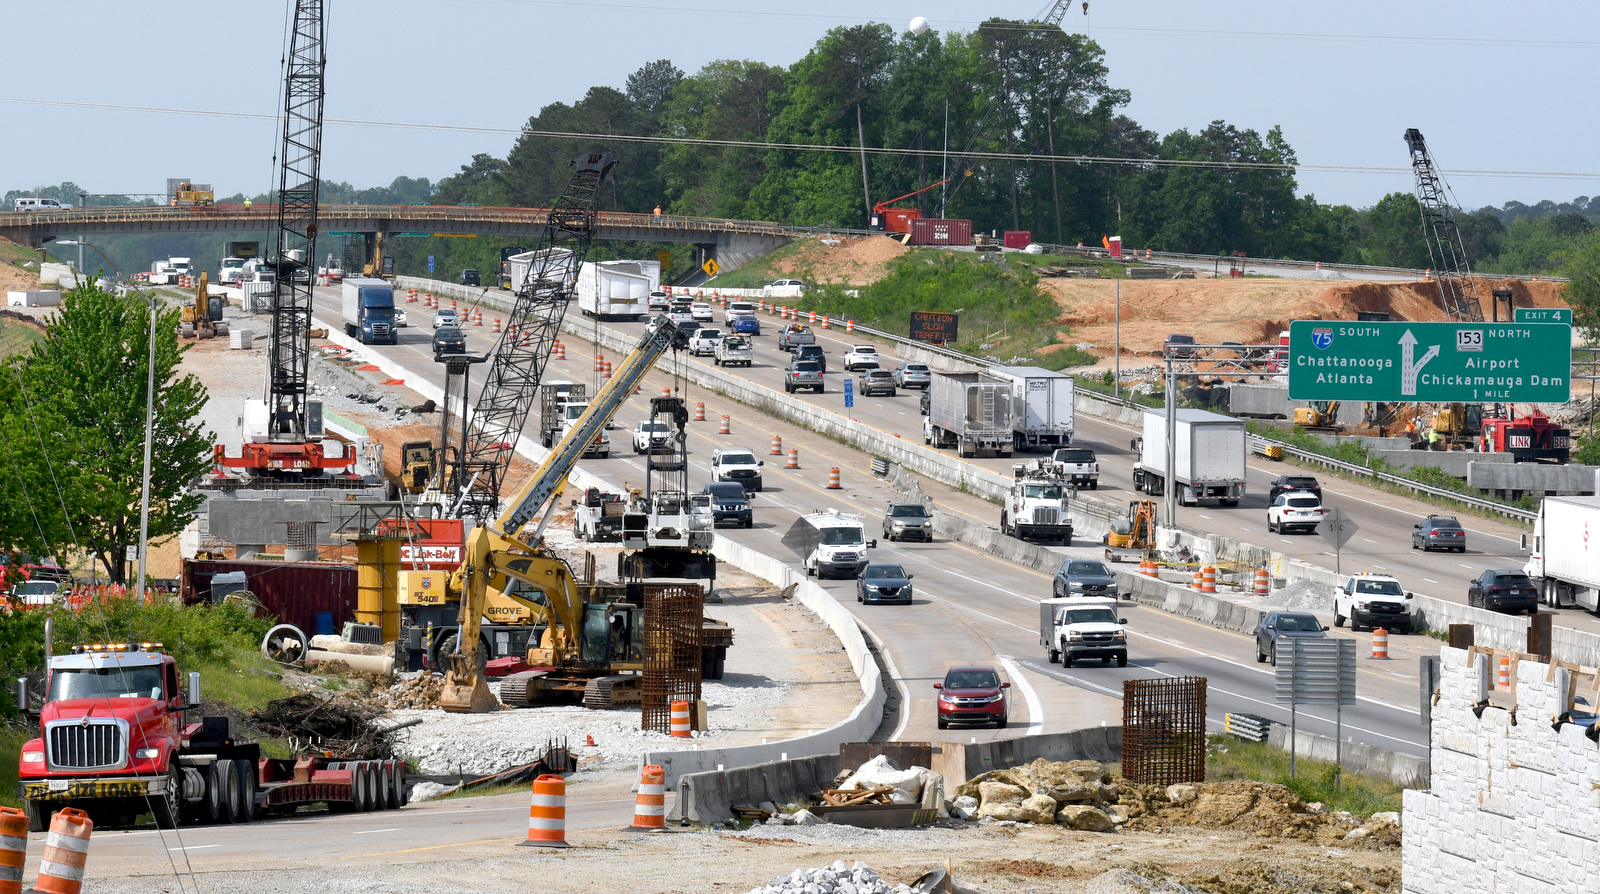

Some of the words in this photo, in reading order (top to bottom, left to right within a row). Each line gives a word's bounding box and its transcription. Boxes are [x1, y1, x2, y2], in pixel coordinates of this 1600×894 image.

[914, 312, 953, 322] CAUTION
[1552, 311, 1562, 320] 4
[914, 330, 952, 340] TRAFFIC
[1339, 328, 1380, 336] SOUTH
[1488, 330, 1530, 338] NORTH
[1314, 333, 1332, 344] 75
[1458, 332, 1481, 344] 153
[1297, 356, 1392, 370] Chattanooga
[1465, 358, 1520, 370] Airport
[1316, 372, 1373, 384] Atlanta
[1422, 374, 1522, 388] Chickamauga
[1530, 374, 1562, 386] Dam
[1473, 389, 1478, 398] 1
[1510, 436, 1530, 447] LINK
[1554, 438, 1569, 448] BELT
[412, 550, 456, 558] Link-Belt
[102, 783, 140, 797] LOAD
